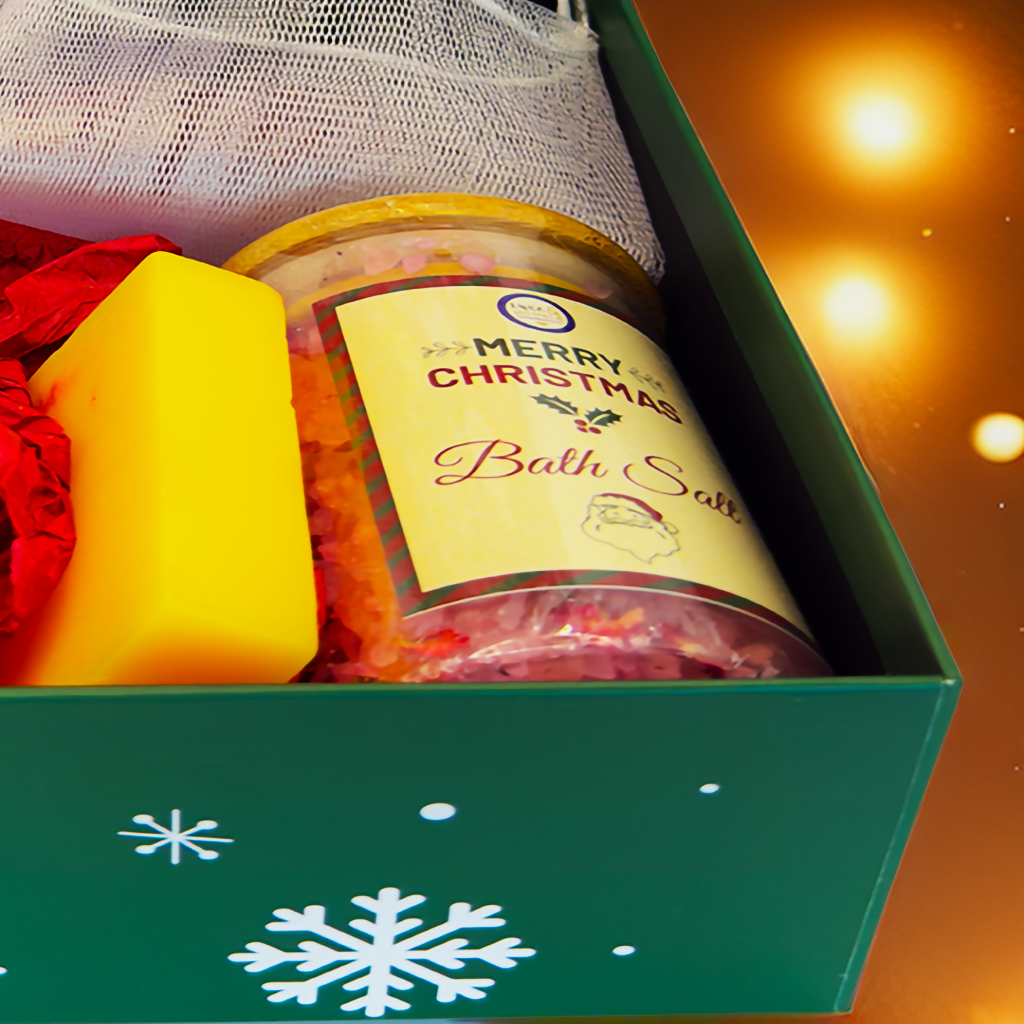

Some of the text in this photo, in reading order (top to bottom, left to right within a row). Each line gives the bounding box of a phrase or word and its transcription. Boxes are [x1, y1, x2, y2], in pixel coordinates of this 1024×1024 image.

[472, 337, 622, 376] MERRY
[427, 364, 683, 425] CHRISTMAS
[434, 438, 742, 524] Bath Salt
